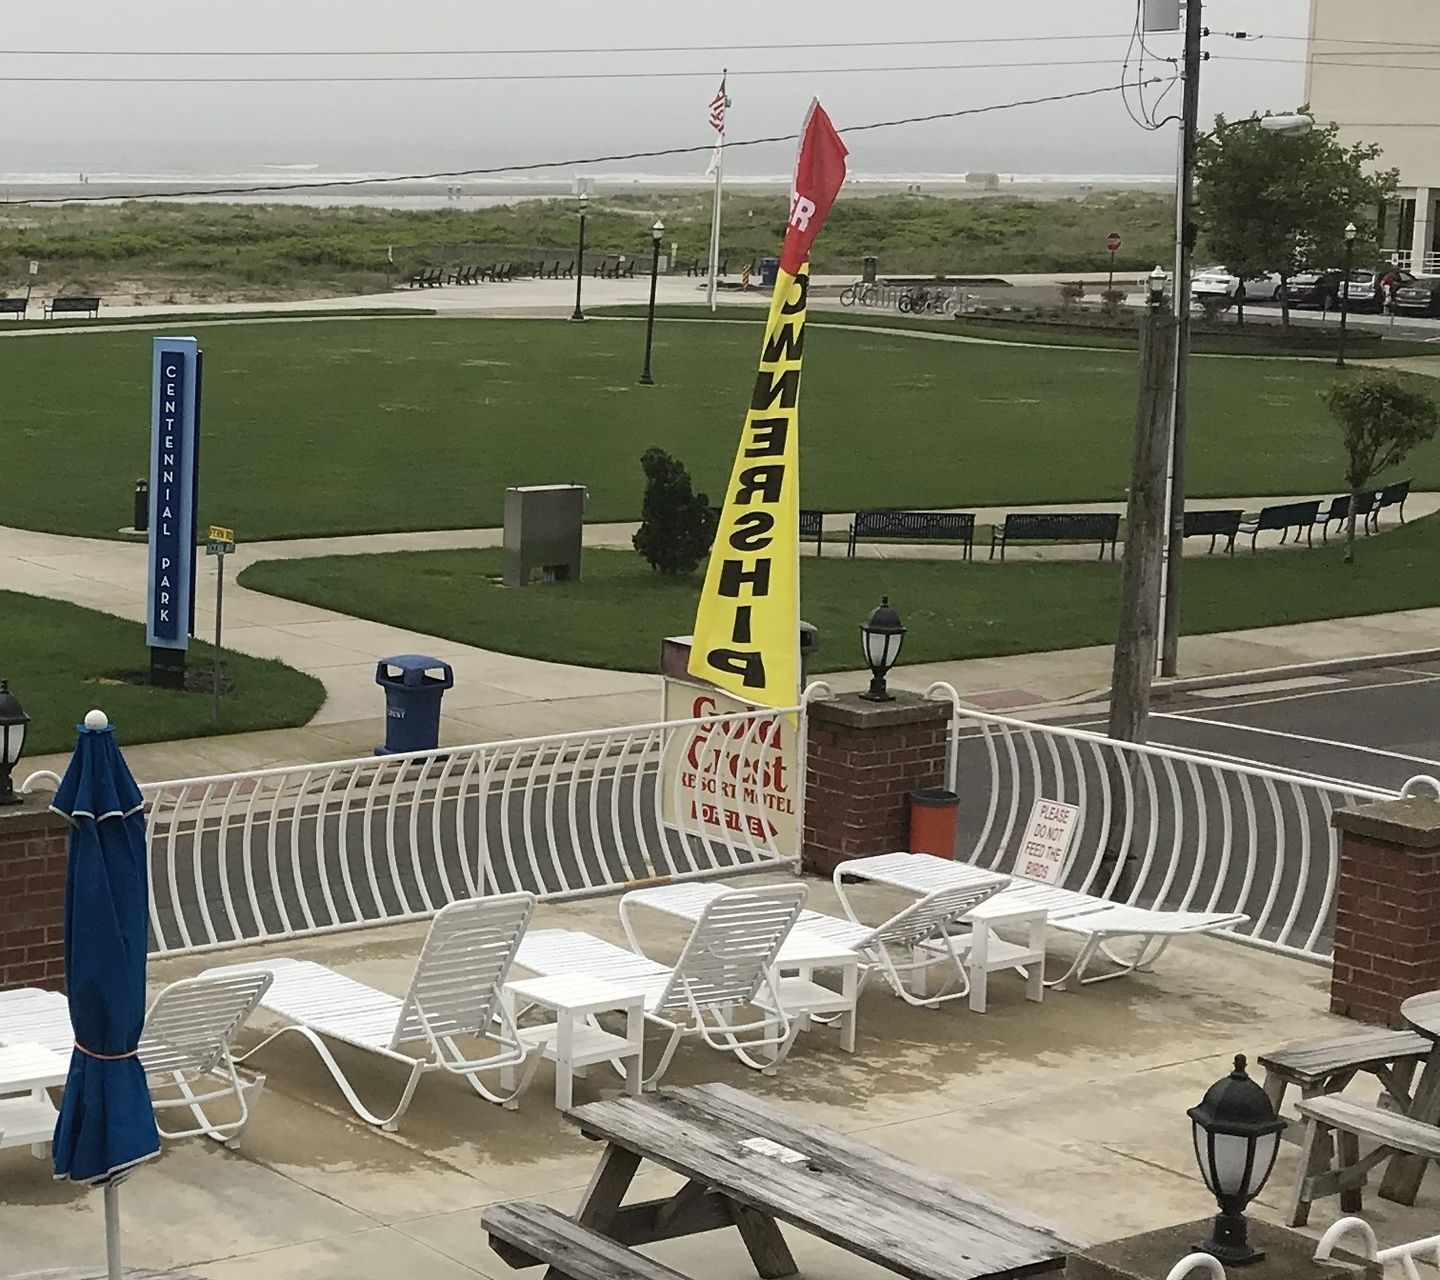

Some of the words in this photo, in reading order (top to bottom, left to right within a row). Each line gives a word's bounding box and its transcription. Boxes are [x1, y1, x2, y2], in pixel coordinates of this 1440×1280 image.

[162, 365, 177, 536] CENTENNIAL
[160, 557, 171, 622] PARK
[1040, 805, 1070, 824] PLEASE
[1033, 823, 1047, 838] DO
[1047, 826, 1064, 842] NOT
[1025, 841, 1046, 858] FEED
[1046, 846, 1062, 862] THE
[1025, 861, 1049, 879] BIRDS
